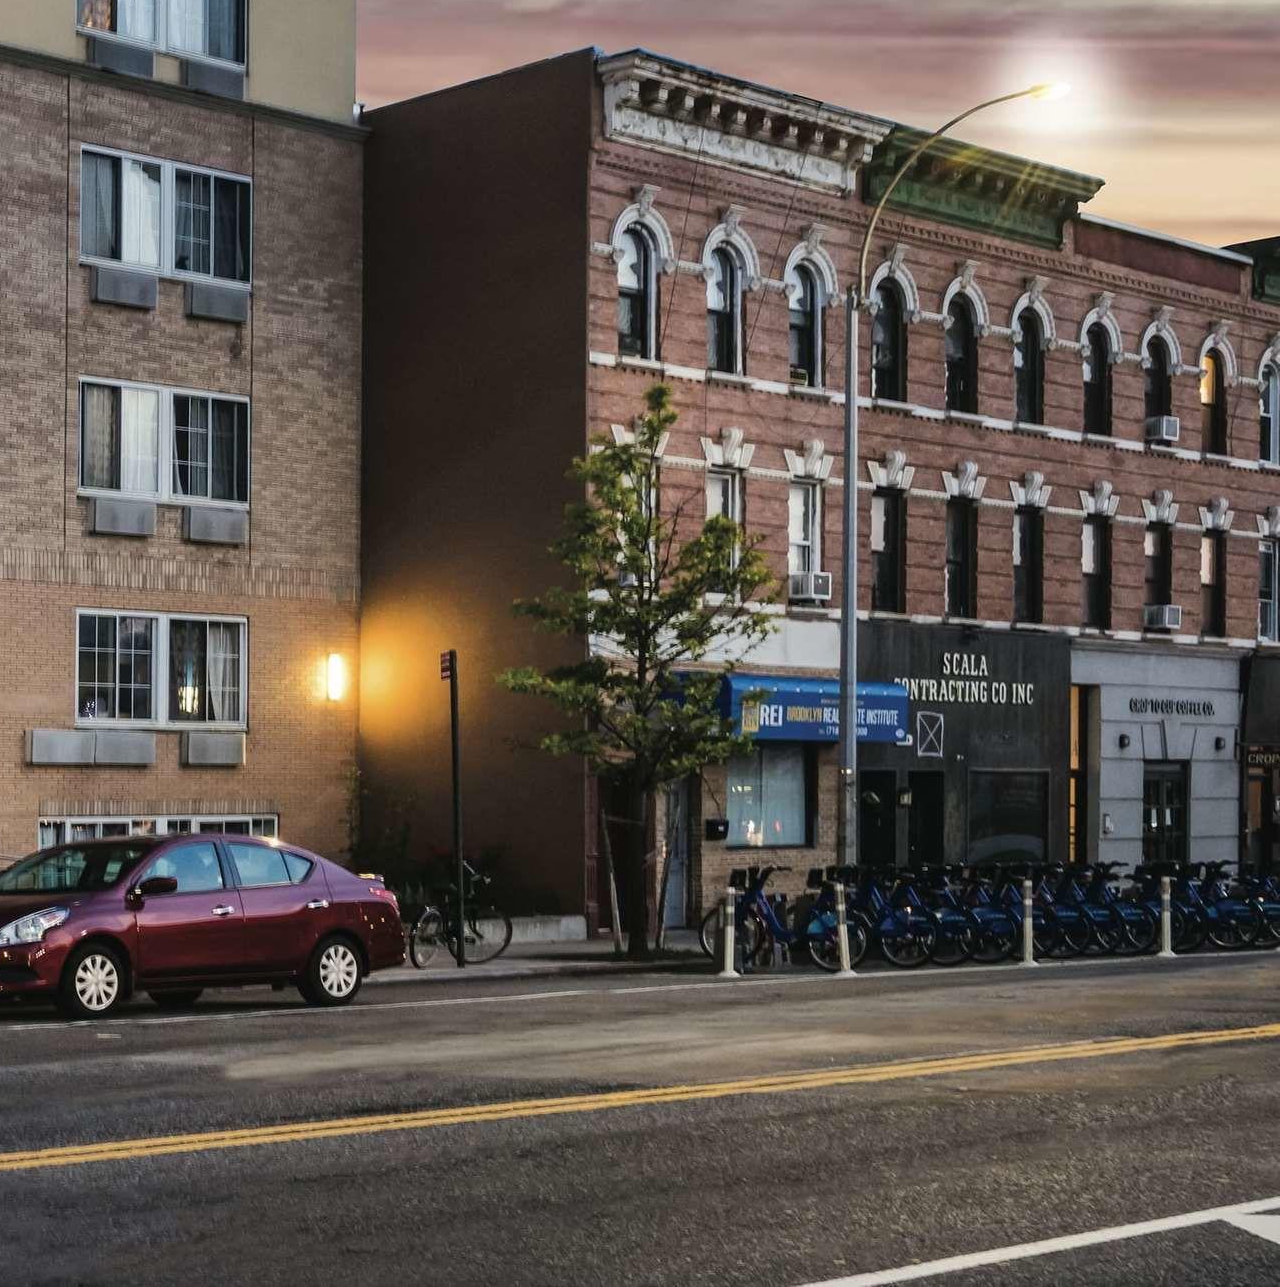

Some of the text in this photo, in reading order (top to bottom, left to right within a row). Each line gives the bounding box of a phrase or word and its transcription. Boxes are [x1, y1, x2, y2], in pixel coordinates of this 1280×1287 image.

[943, 652, 989, 677] SCALA
[894, 677, 1034, 705] ONTRACTING CO INC
[760, 704, 783, 727] REI
[823, 707, 840, 724] REAL
[866, 710, 898, 726] INSTITUTE
